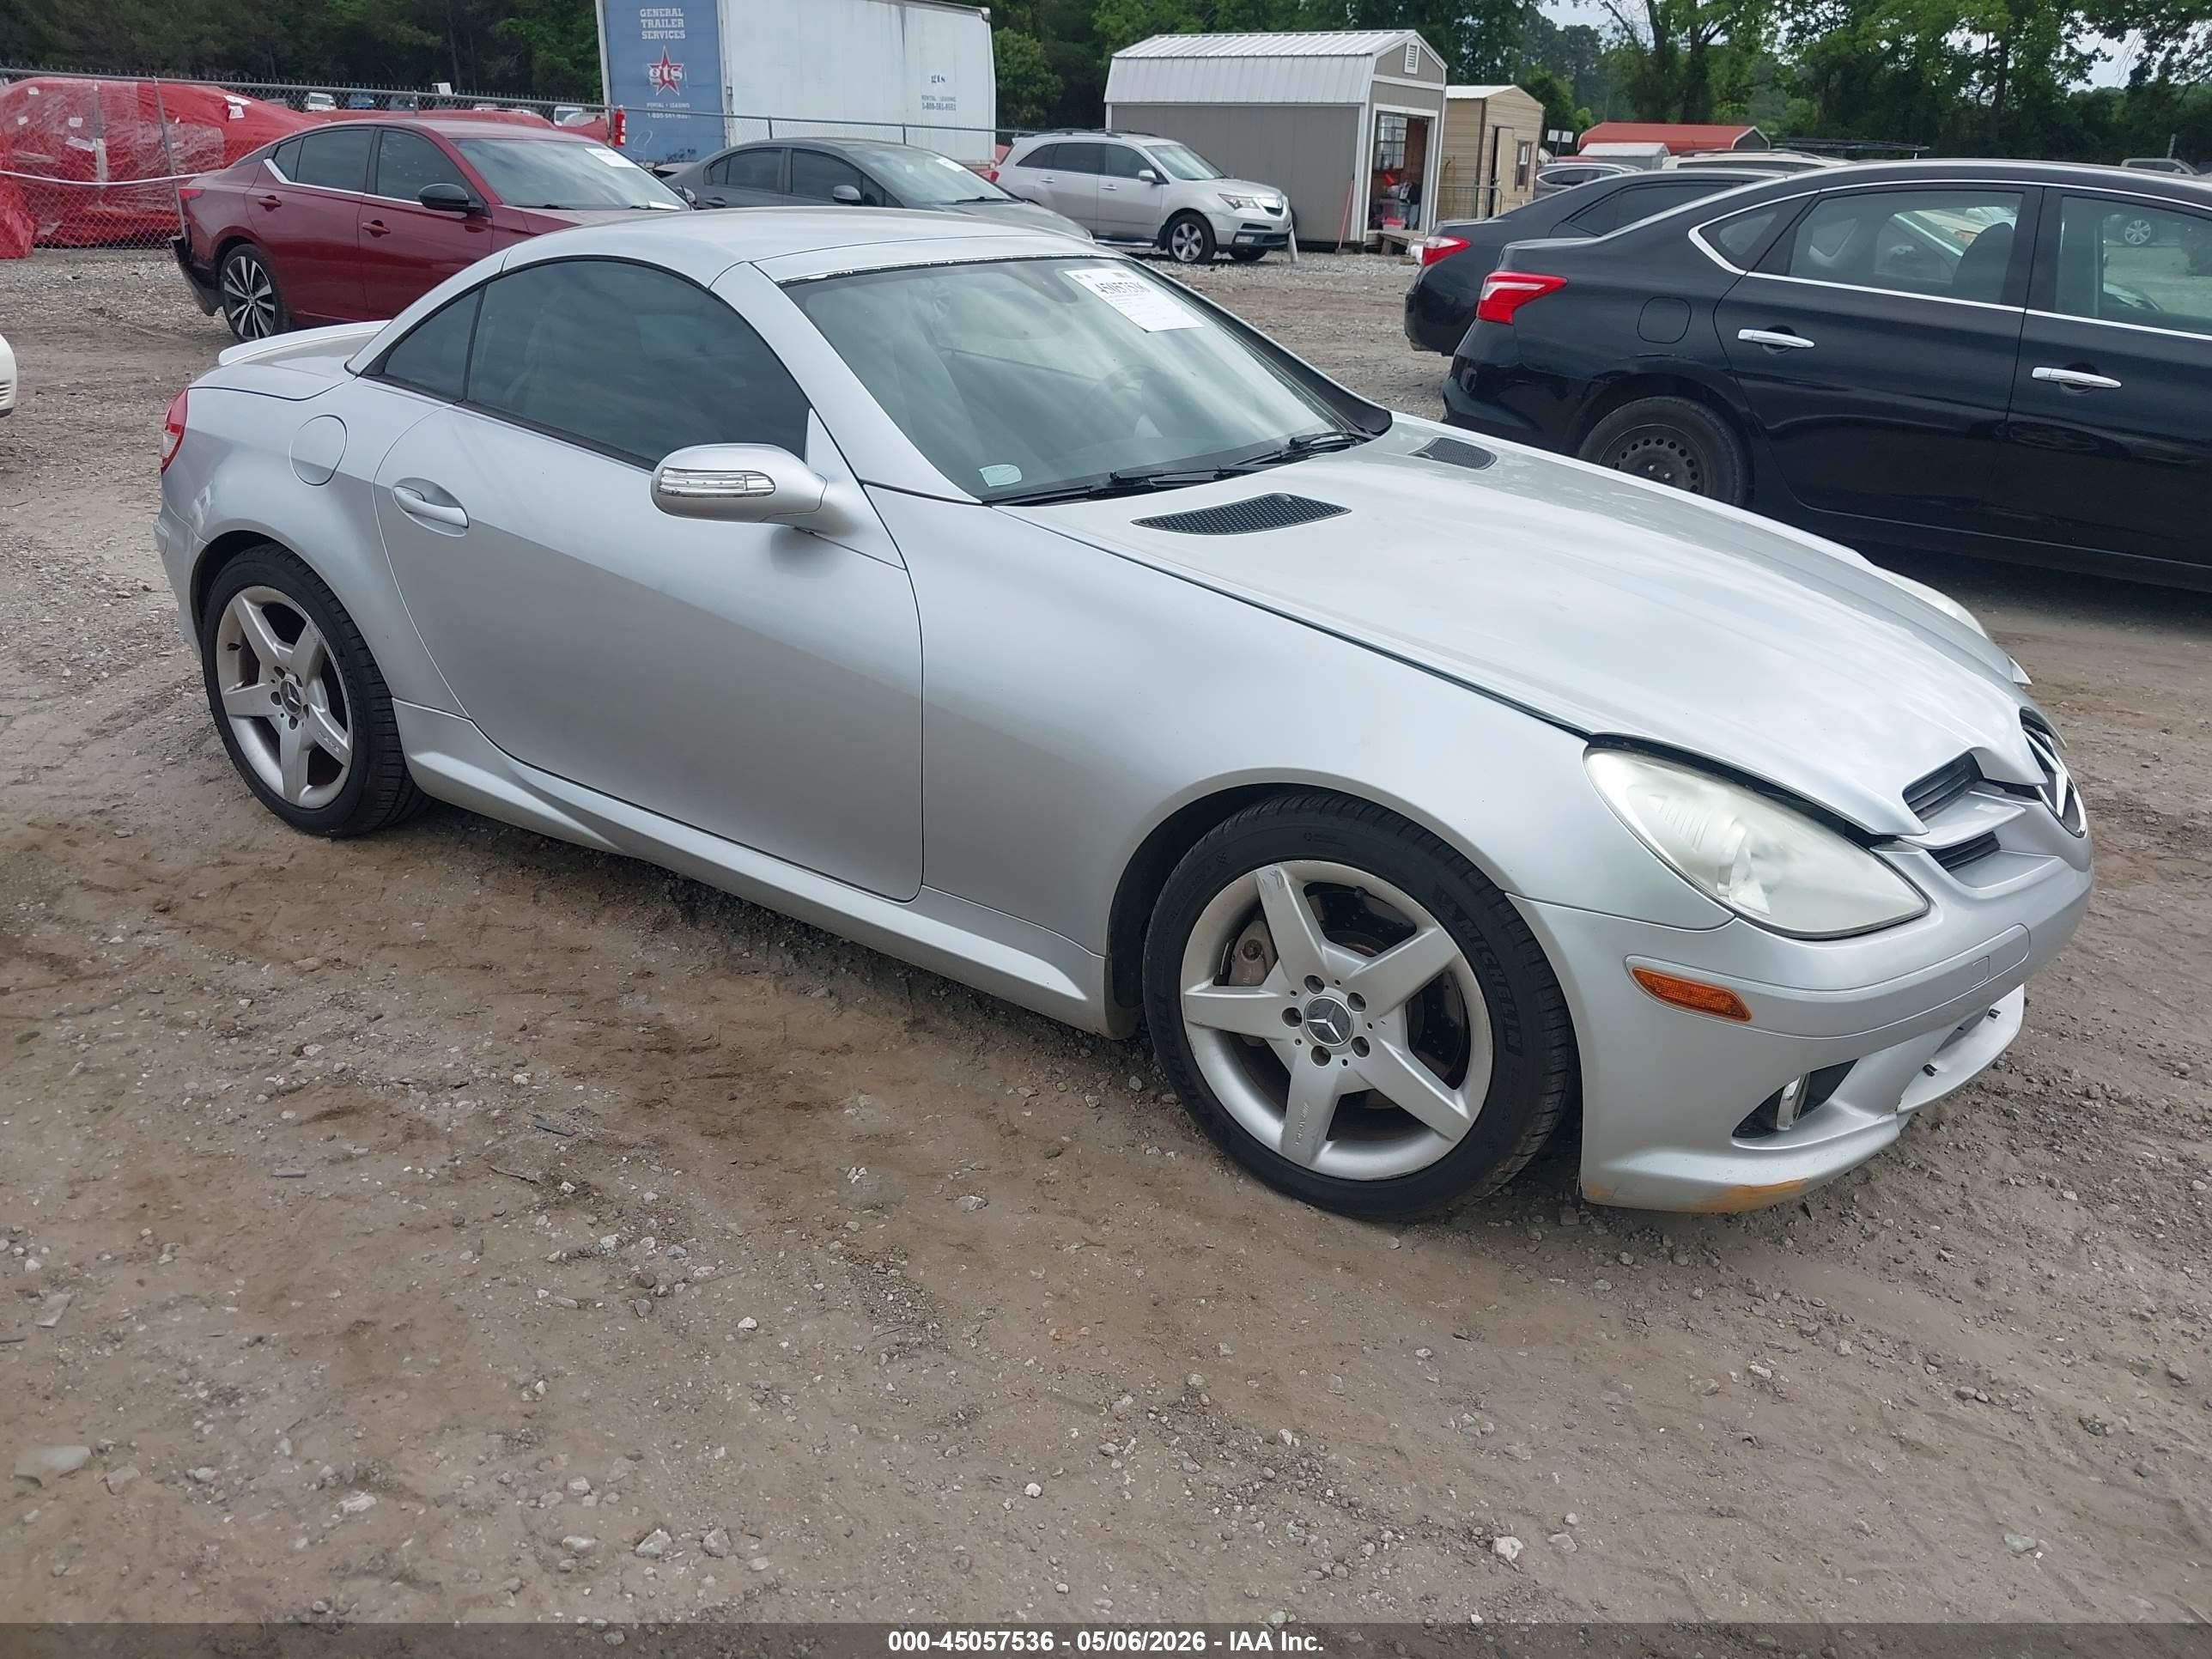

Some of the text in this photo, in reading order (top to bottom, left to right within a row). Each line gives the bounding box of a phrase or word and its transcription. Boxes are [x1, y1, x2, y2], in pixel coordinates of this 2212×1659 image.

[640, 9, 684, 17] GENERAL
[641, 19, 684, 28] TRAILER
[641, 30, 686, 40] SERVICES
[648, 64, 683, 87] gts
[931, 75, 946, 83] gts
[1094, 282, 1151, 295] 45057536
[1456, 918, 1523, 1054] MICHELIN
